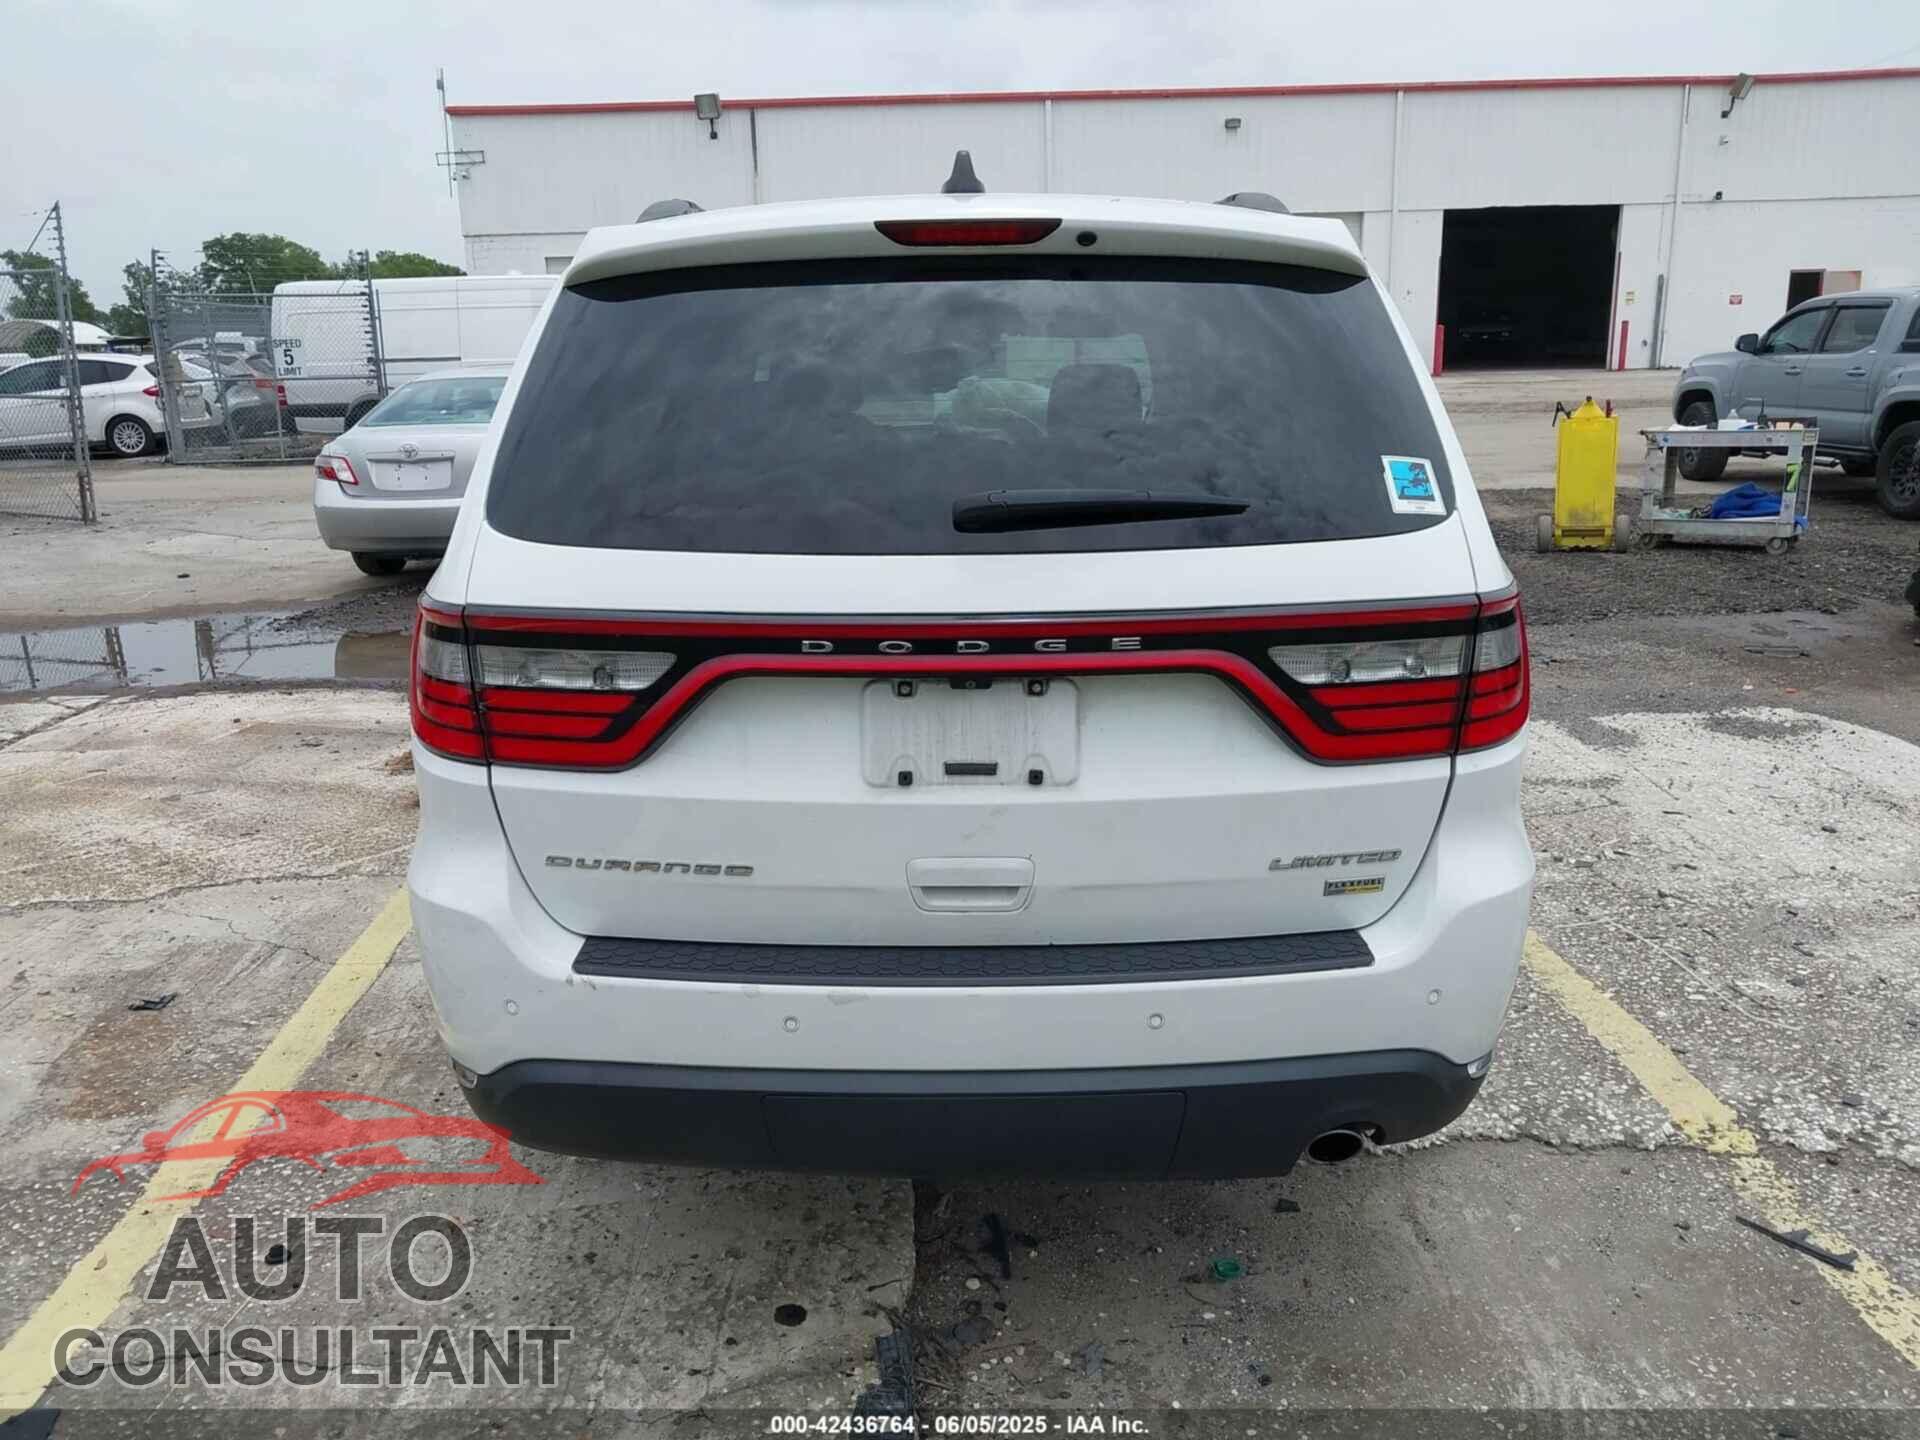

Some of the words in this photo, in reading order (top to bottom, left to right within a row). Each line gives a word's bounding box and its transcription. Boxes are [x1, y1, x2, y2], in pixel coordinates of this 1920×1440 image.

[273, 339, 302, 348] SPEED
[283, 348, 294, 366] 5
[279, 367, 302, 377] LIMIT
[801, 637, 1142, 653] DODGE
[545, 855, 754, 876] DURANGO
[1268, 849, 1402, 871] LIMITED
